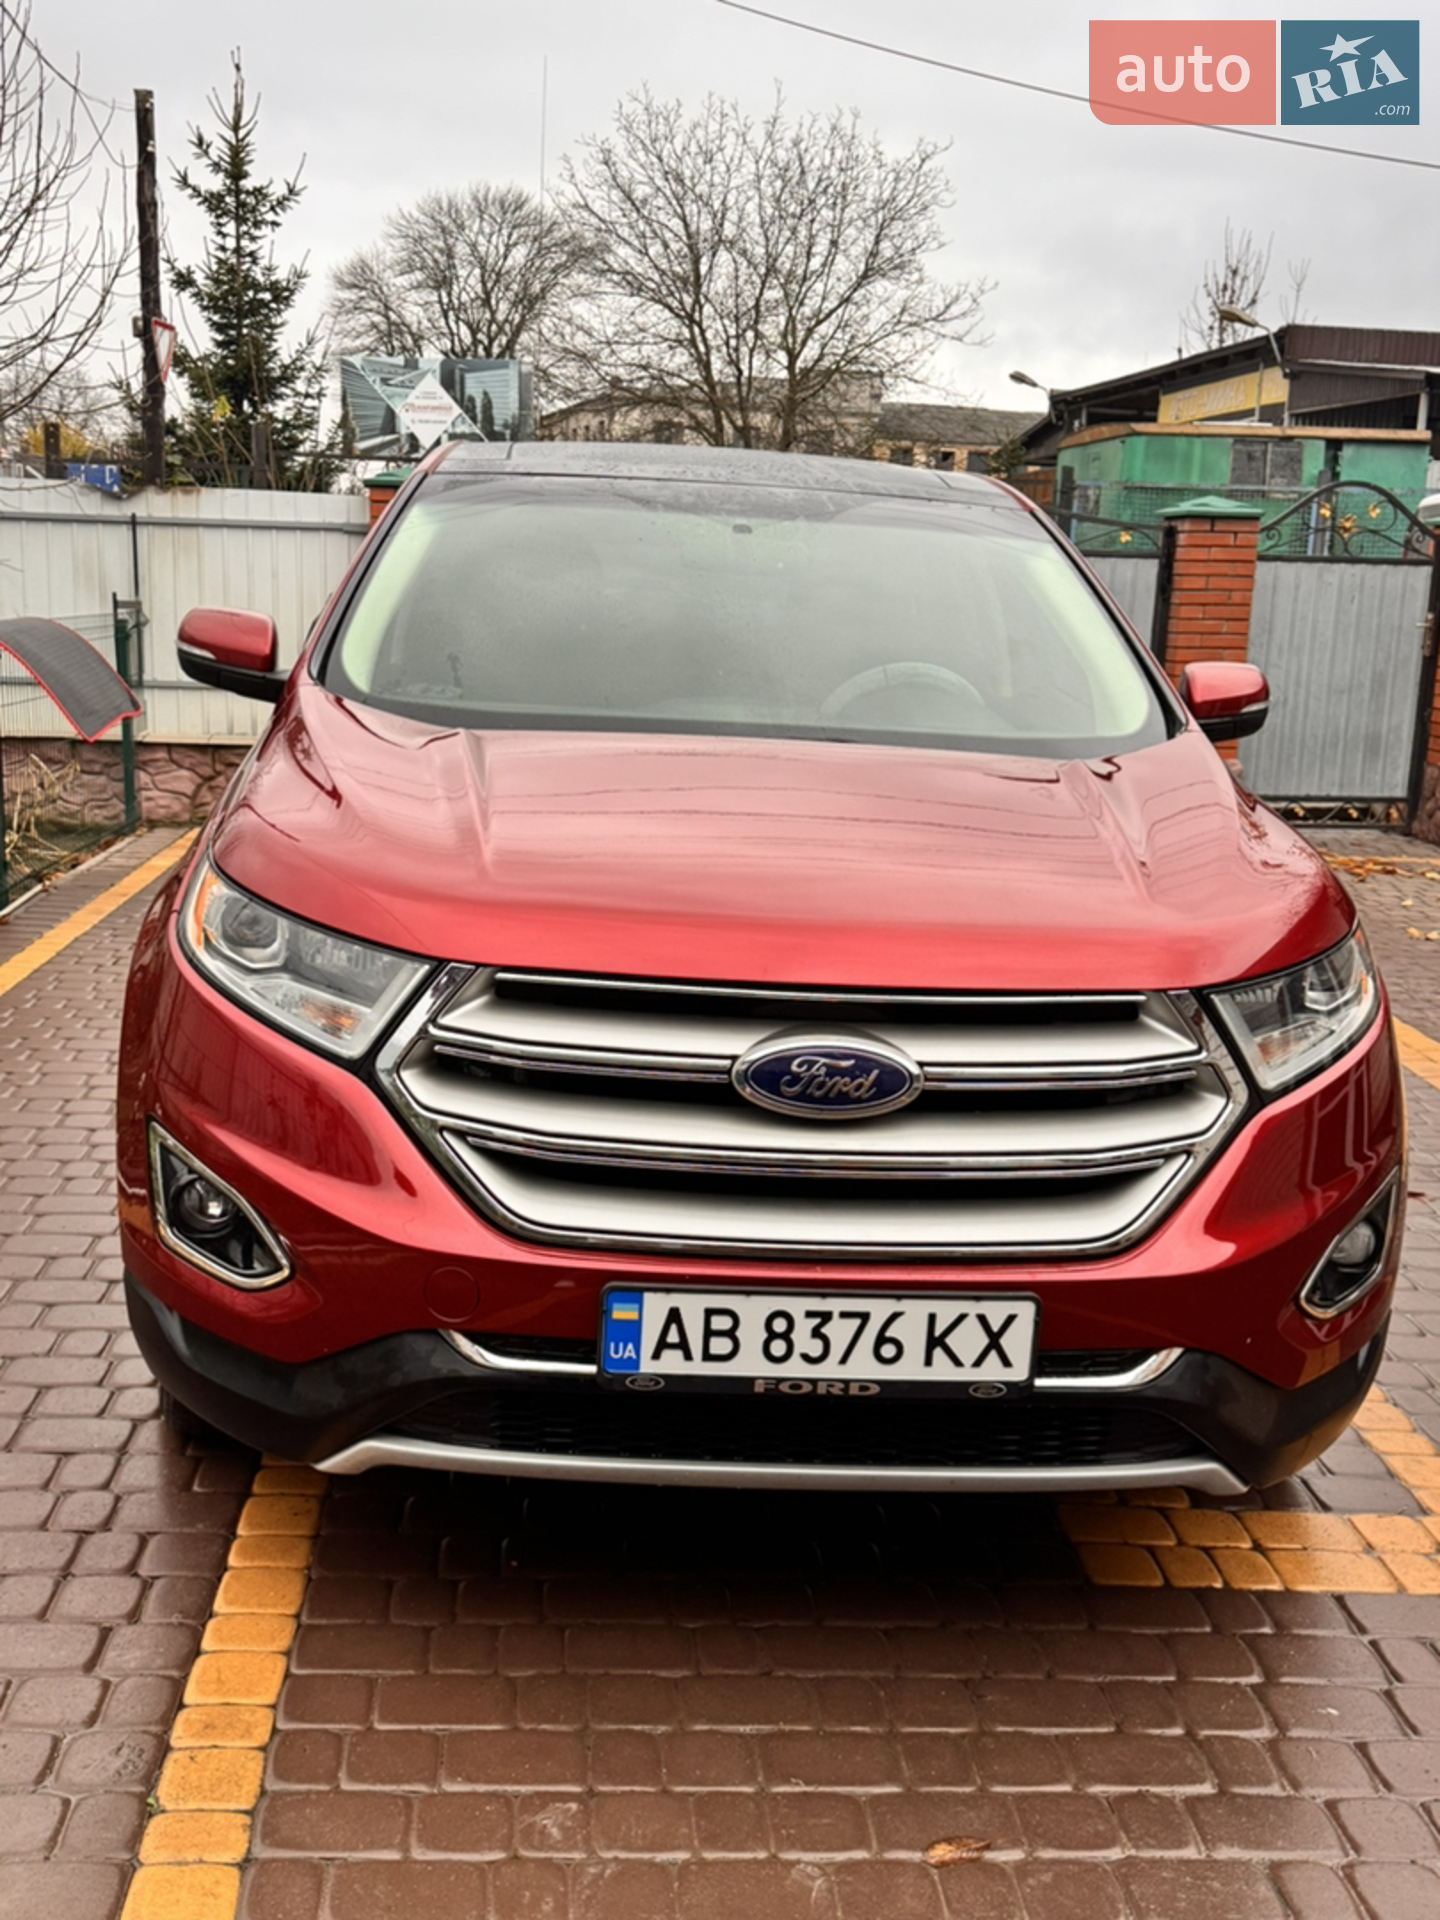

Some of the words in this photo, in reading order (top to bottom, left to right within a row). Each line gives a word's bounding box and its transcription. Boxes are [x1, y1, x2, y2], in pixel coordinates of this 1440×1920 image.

[780, 1055, 880, 1100] Ford
[609, 1341, 637, 1360] UA
[650, 1306, 741, 1363] AB
[762, 1309, 906, 1366] 8376
[923, 1312, 1019, 1368] KX
[753, 1379, 881, 1396] FORD
